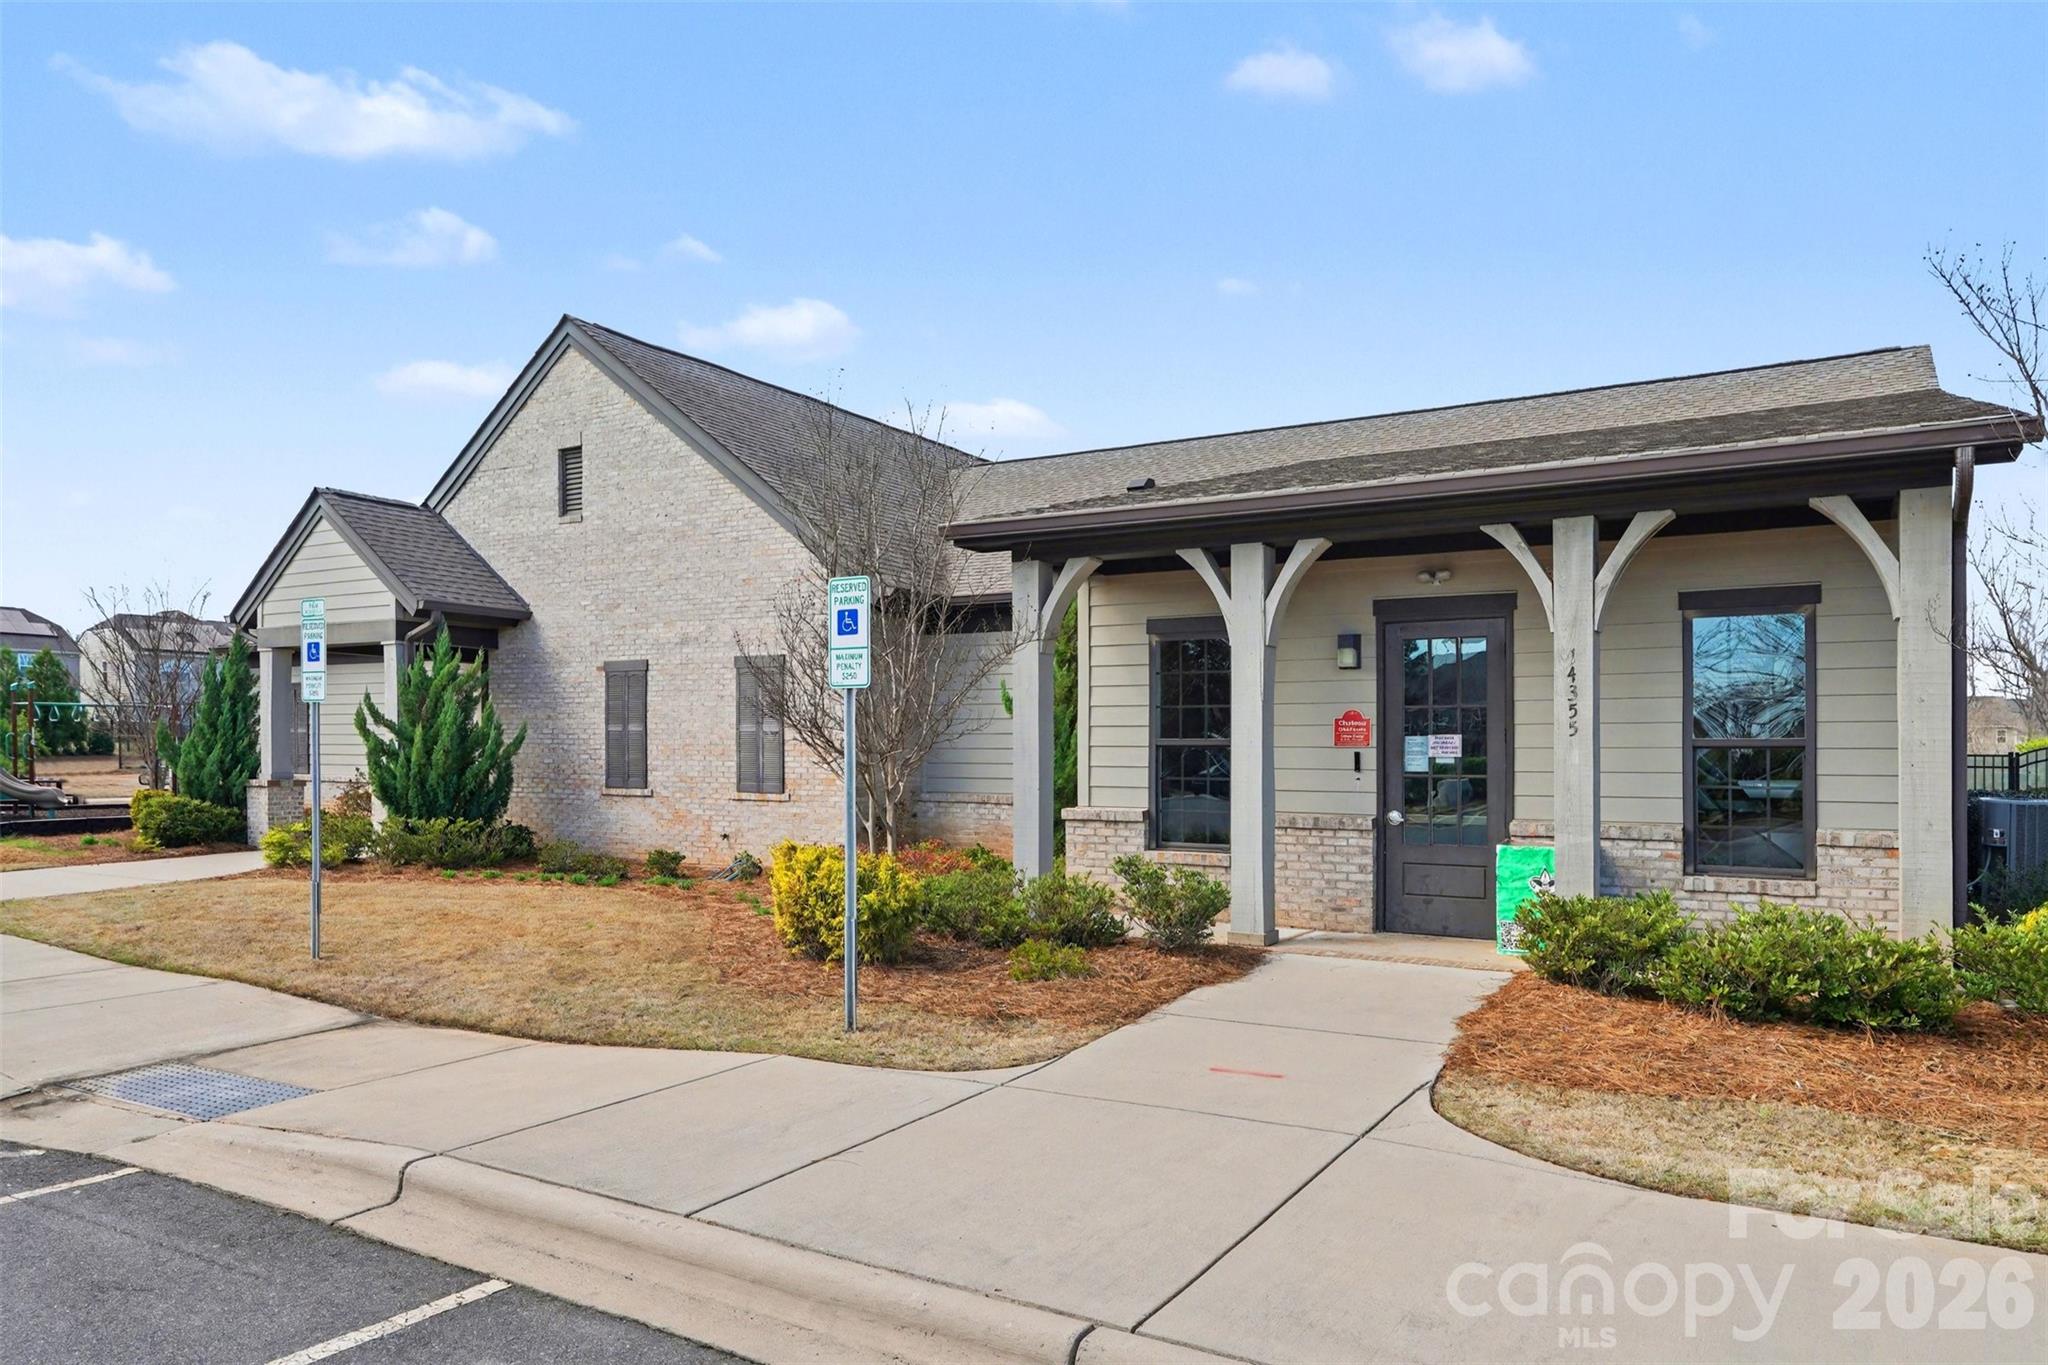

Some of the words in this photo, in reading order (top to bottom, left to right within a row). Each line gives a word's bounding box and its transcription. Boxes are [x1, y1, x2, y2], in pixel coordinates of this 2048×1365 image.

[831, 582, 867, 593] RESERVED
[834, 595, 865, 605] PARKING
[836, 662, 862, 671] PENALTY
